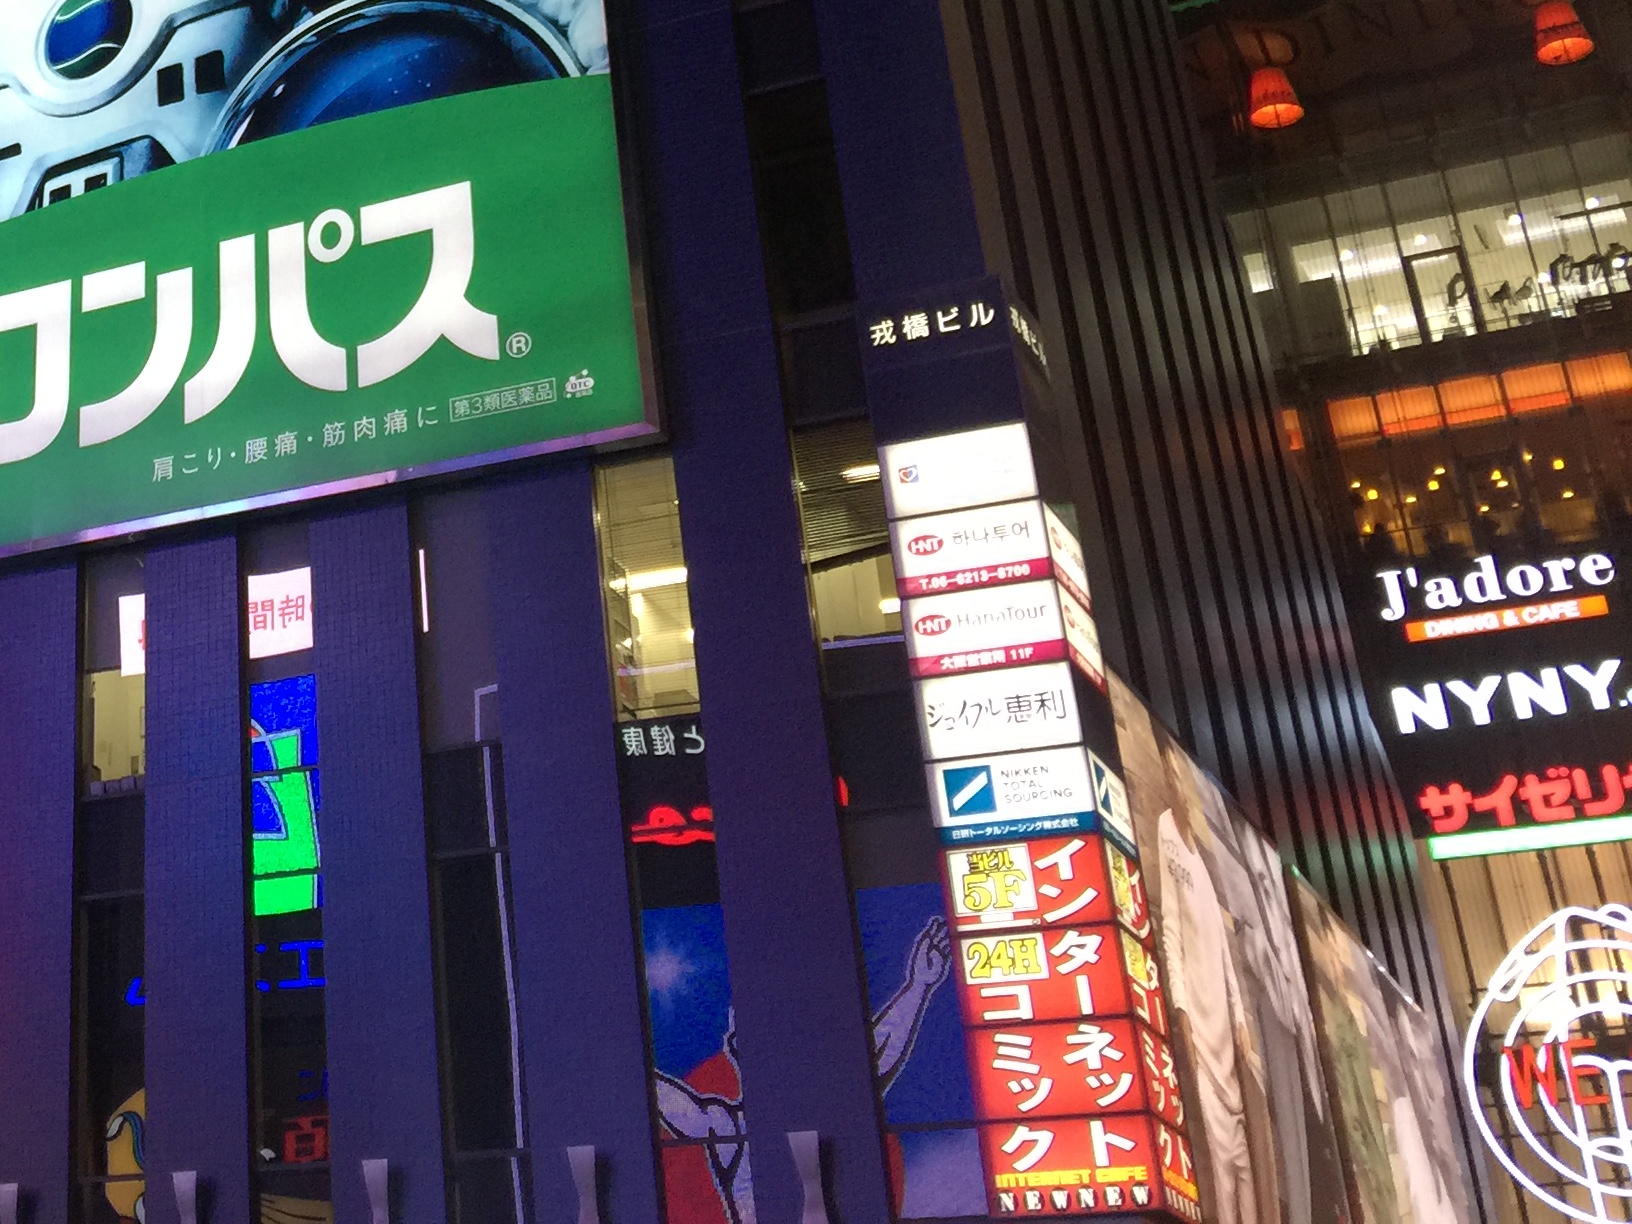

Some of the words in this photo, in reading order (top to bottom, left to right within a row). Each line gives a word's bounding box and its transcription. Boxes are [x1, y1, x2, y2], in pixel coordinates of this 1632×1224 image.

[869, 302, 995, 347] 戎橋ビル
[152, 405, 439, 483] 肩こり・腰痛・筋肉痛に
[452, 381, 554, 420] 第3類医薬品
[952, 521, 1030, 545] 하나투어
[1375, 551, 1616, 621] J'adore
[1520, 600, 1581, 625] CAFE
[1001, 765, 1050, 778] NIKKEN
[1003, 779, 1044, 791] TOTAL
[1005, 788, 1074, 804] SOURCING
[1418, 764, 1632, 834] サイゼリ
[963, 869, 1028, 912] 5F
[967, 938, 1041, 979] 24H
